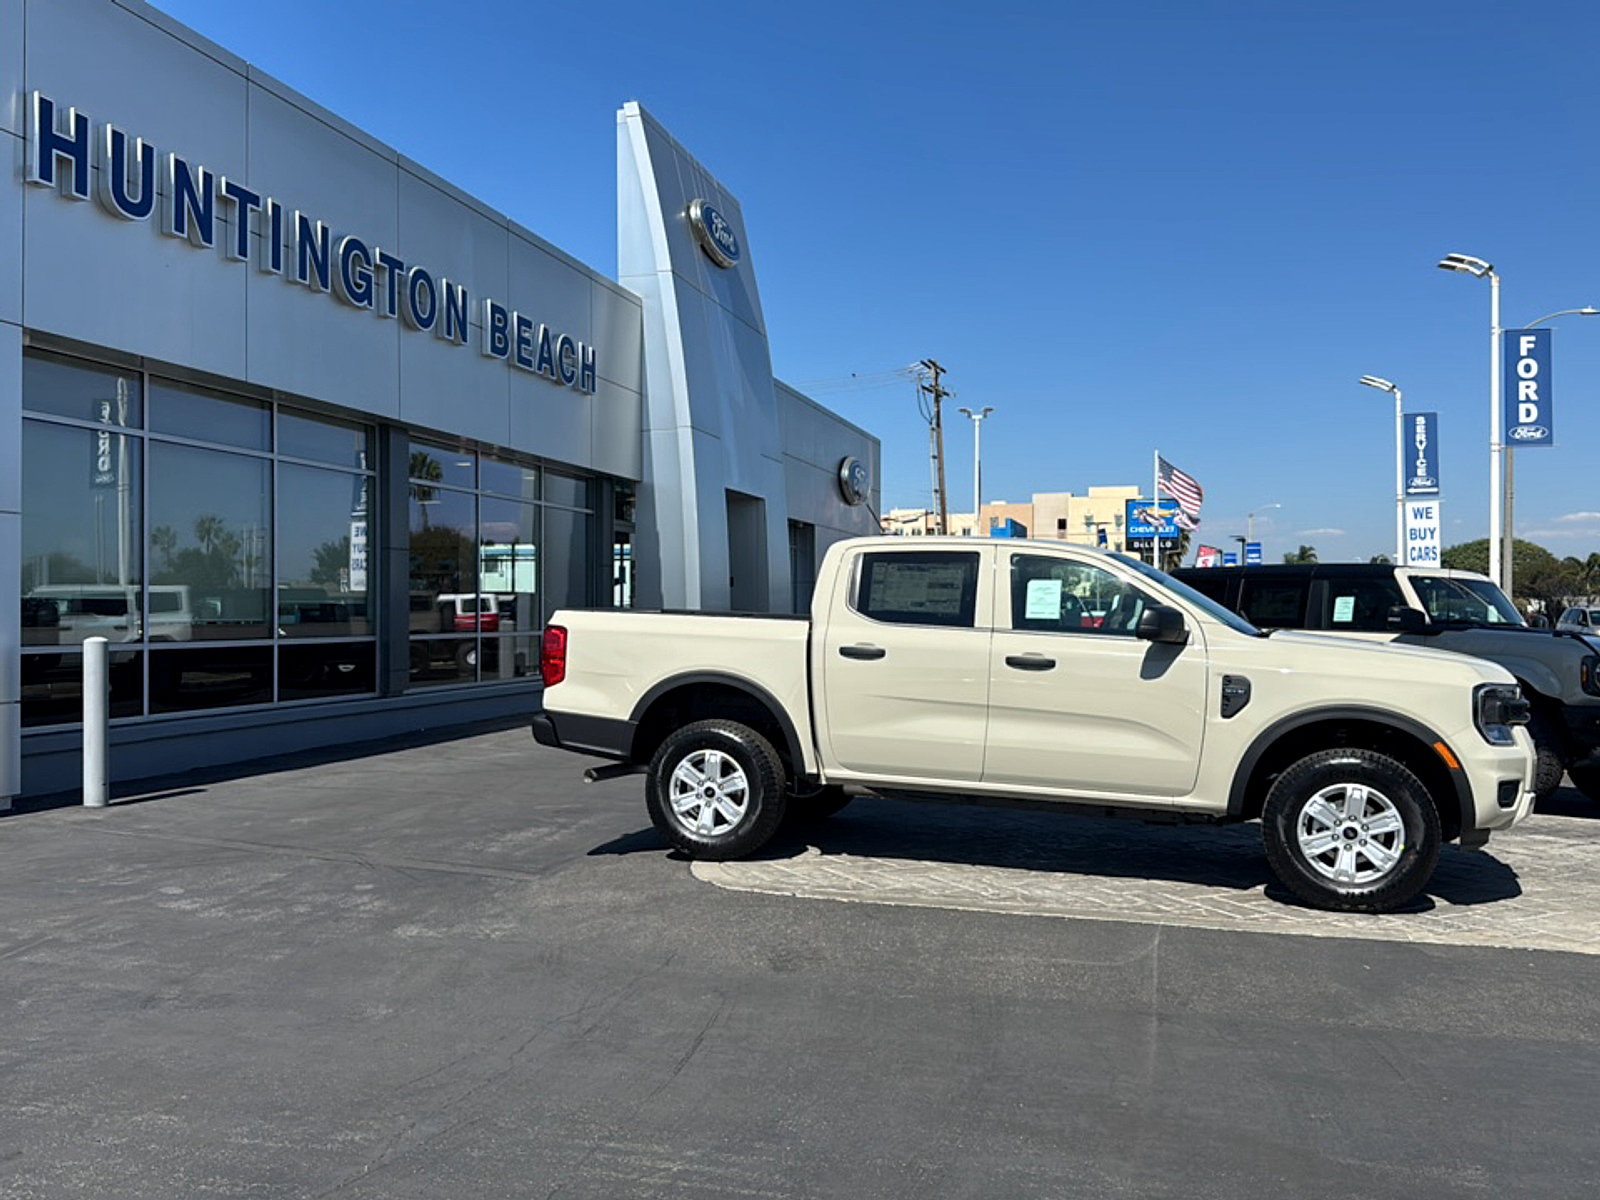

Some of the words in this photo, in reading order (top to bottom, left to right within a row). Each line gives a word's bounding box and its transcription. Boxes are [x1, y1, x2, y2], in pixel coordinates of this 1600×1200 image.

[26, 90, 470, 345] HUNTINGTON
[482, 298, 598, 395] BEACH
[711, 211, 736, 253] Ford
[1516, 335, 1539, 424] FORD
[1415, 416, 1427, 477] SERVICE
[1513, 426, 1545, 440] Ford
[1412, 507, 1433, 520] WE
[1410, 527, 1436, 540] BUY
[1410, 546, 1437, 562] CARS
